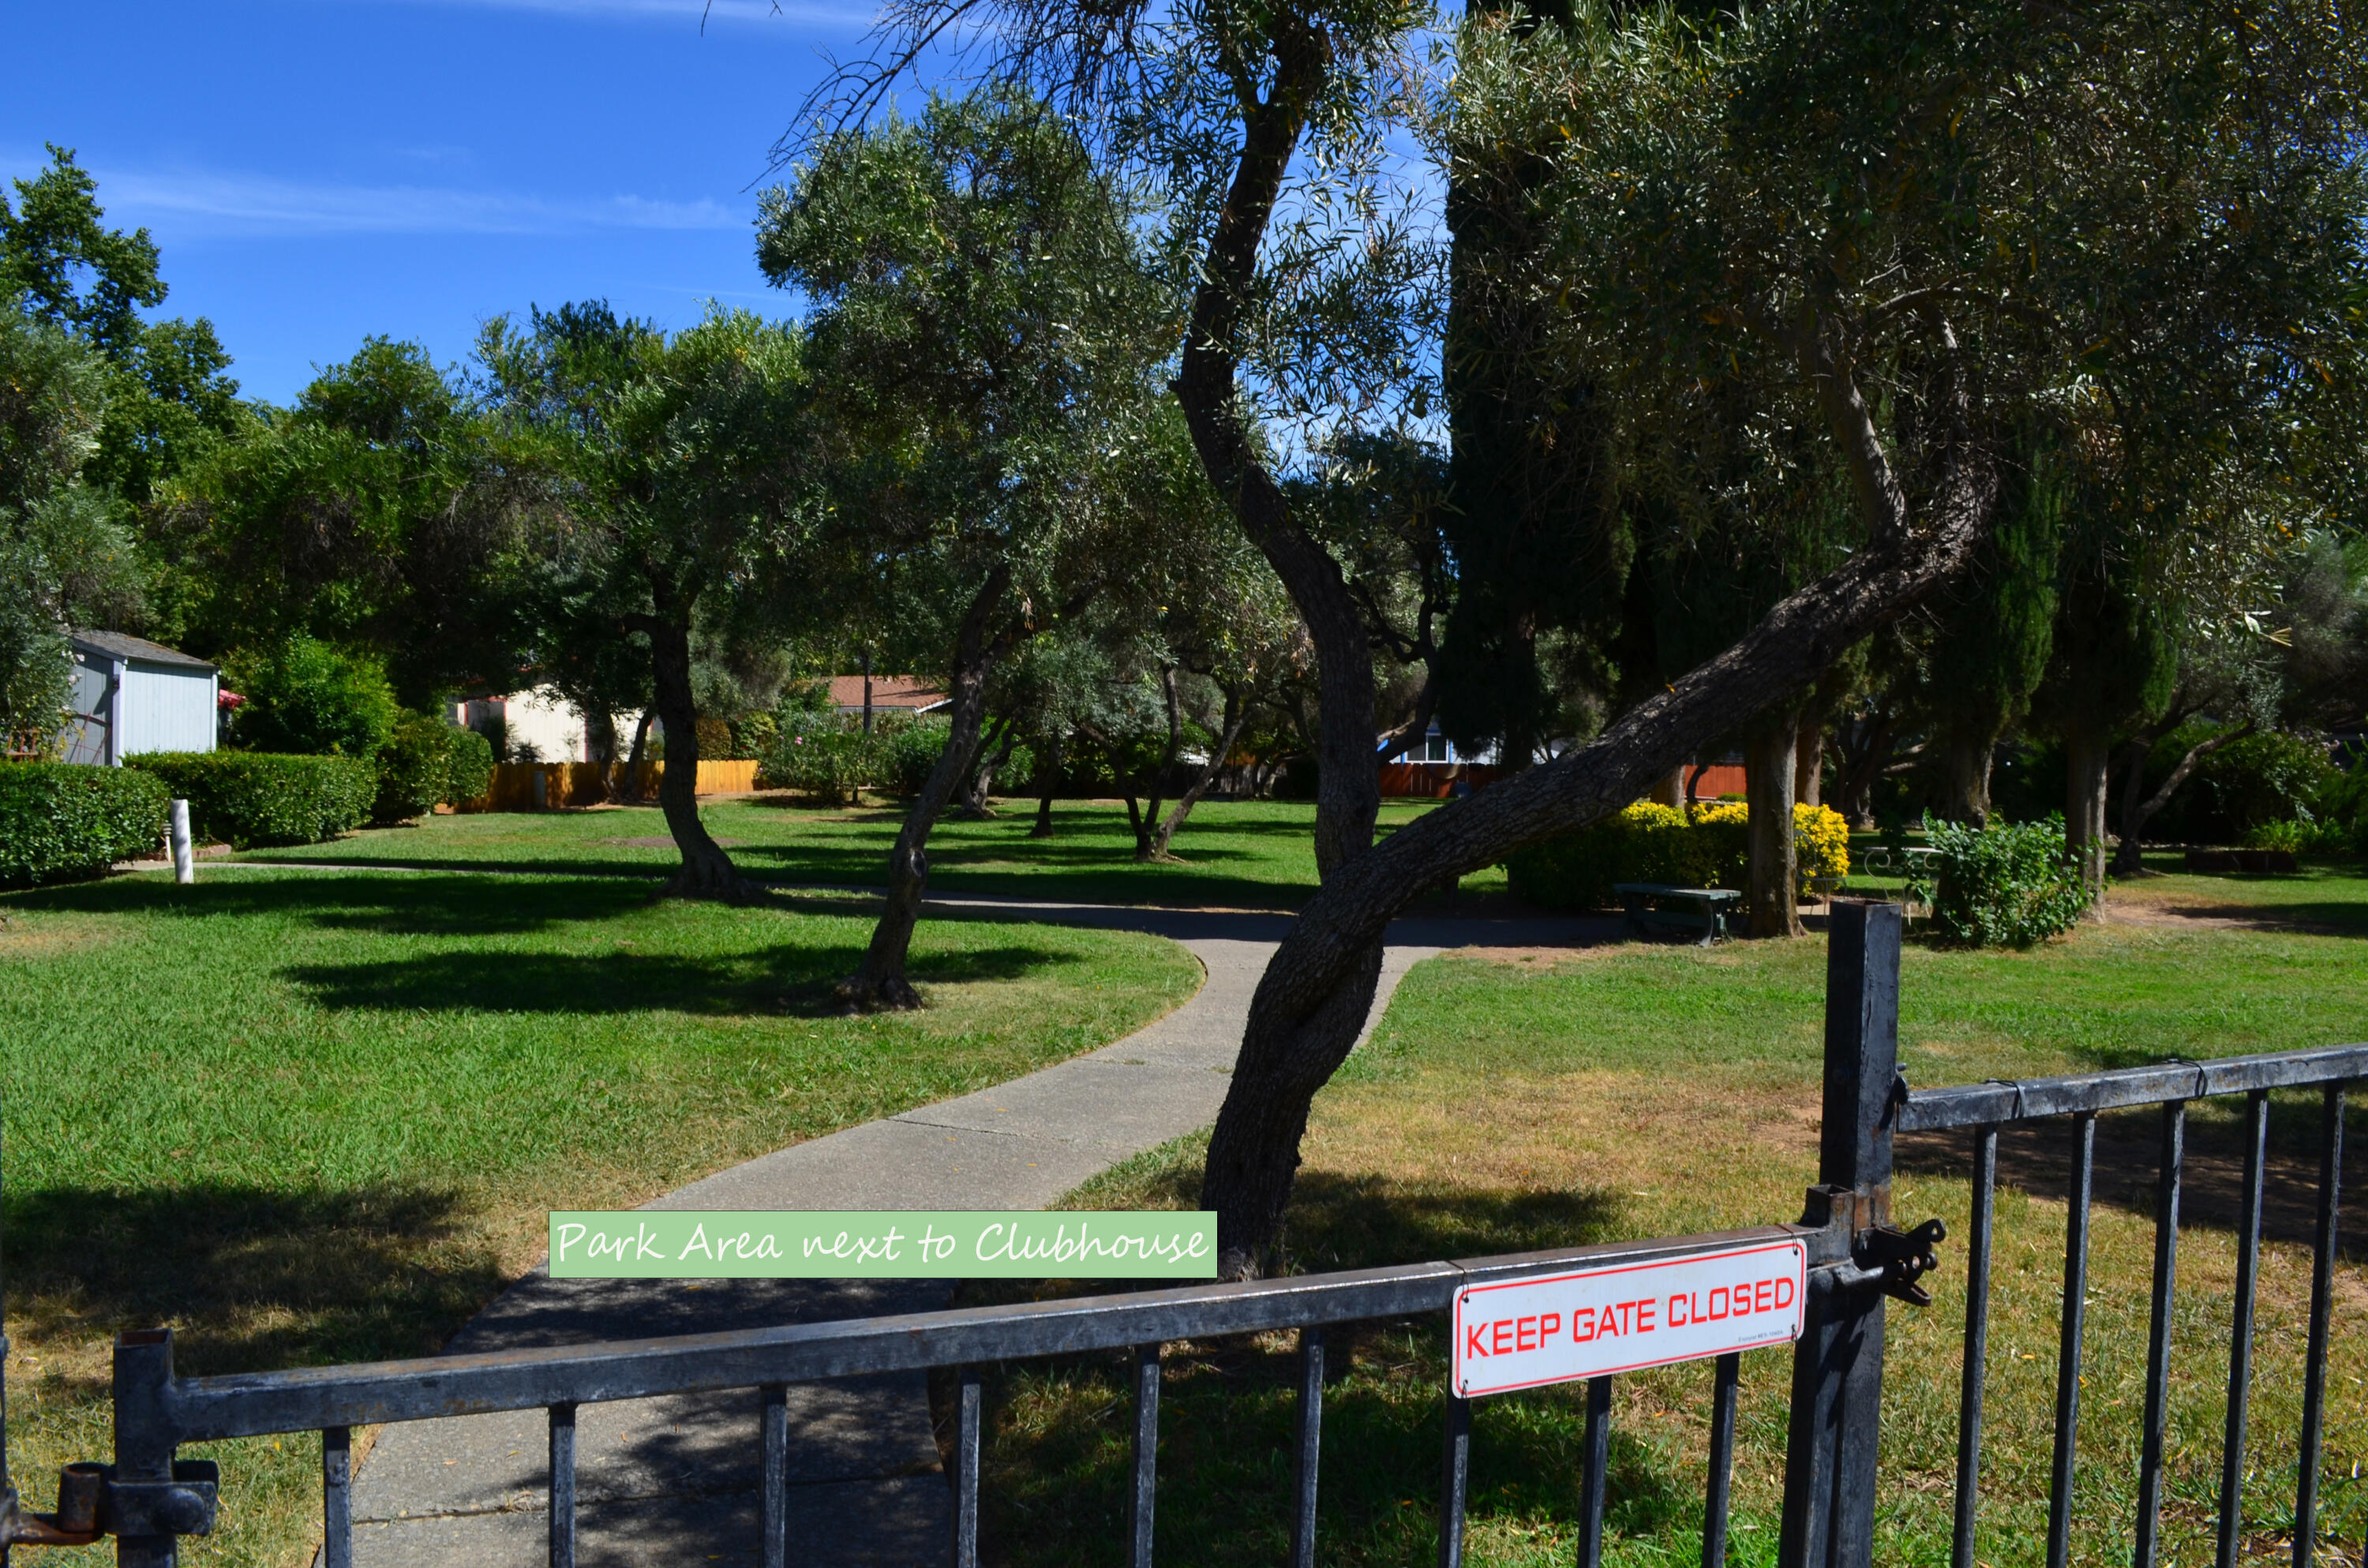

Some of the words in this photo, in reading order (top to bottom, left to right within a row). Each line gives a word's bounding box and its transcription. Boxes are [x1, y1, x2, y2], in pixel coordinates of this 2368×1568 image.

[1467, 1312, 1561, 1360] KEEP
[1572, 1297, 1657, 1344] GATE
[1668, 1277, 1795, 1328] CLOSED
